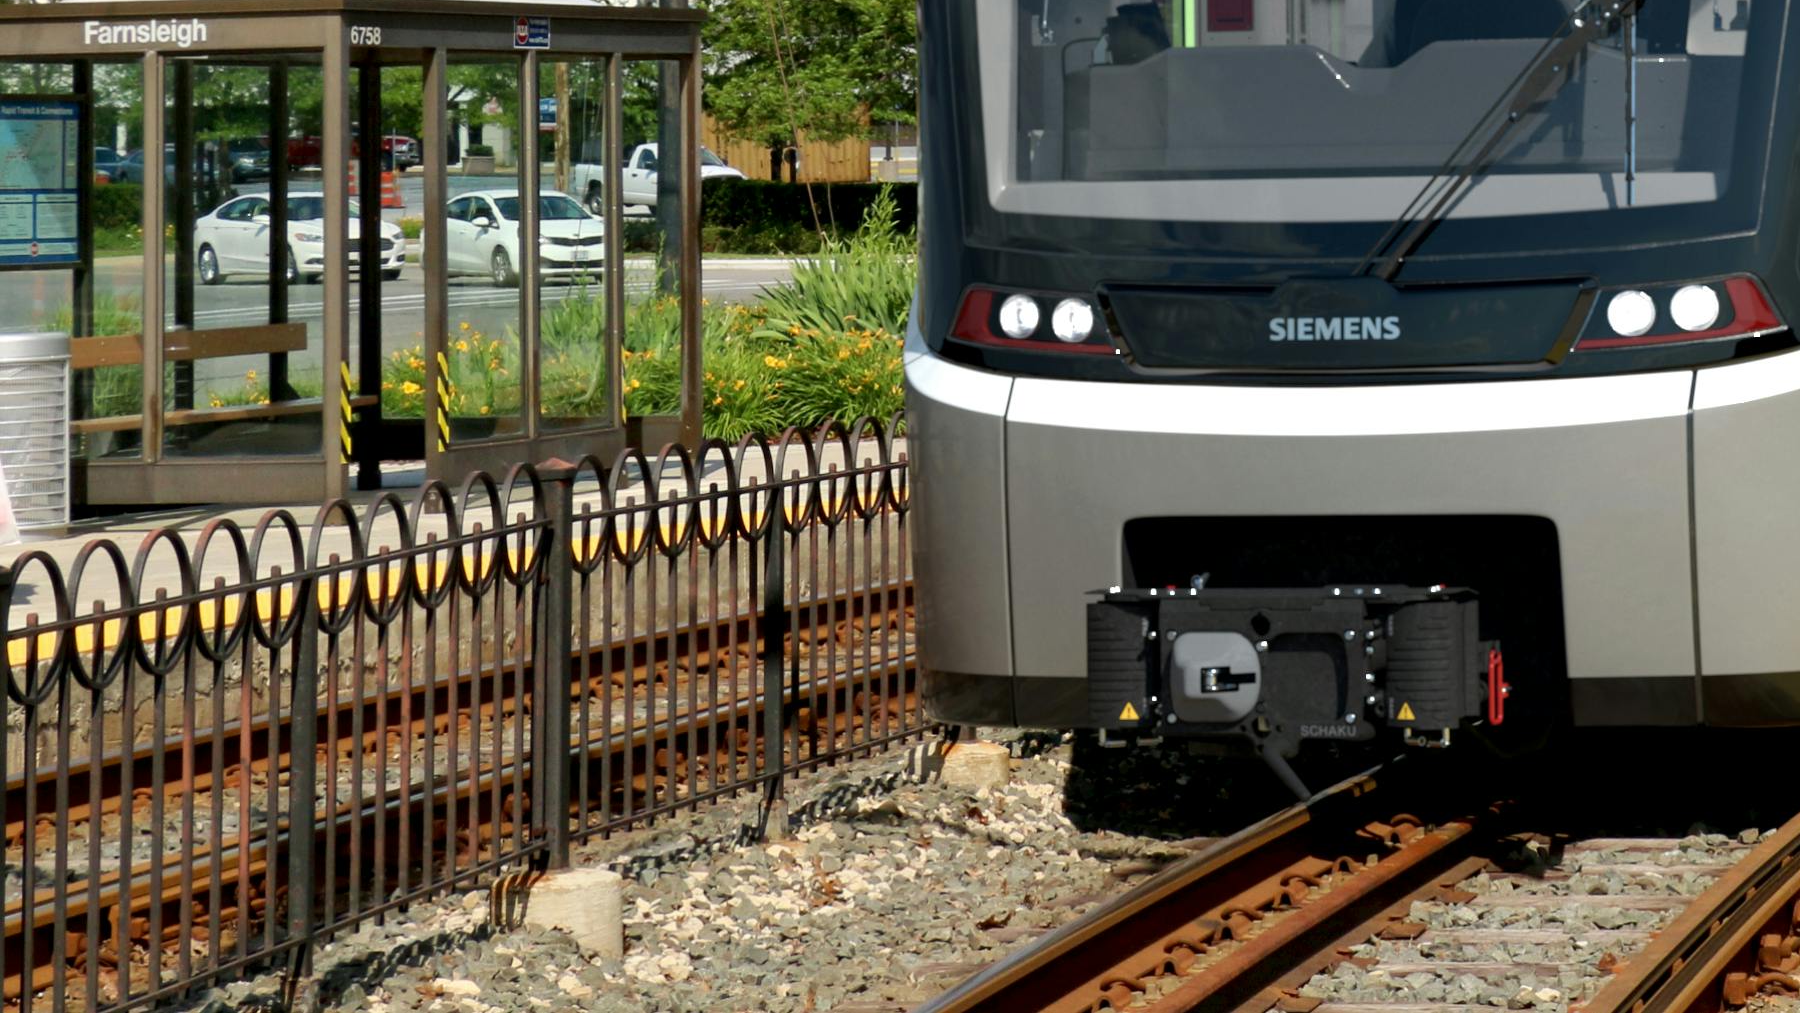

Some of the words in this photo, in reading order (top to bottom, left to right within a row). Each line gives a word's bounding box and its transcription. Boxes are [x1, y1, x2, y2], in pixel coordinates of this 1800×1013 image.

[83, 18, 208, 48] Farnsleigh
[350, 25, 382, 46] 6758
[1268, 316, 1401, 342] SIEMENS
[1299, 724, 1357, 738] SCHAKU
